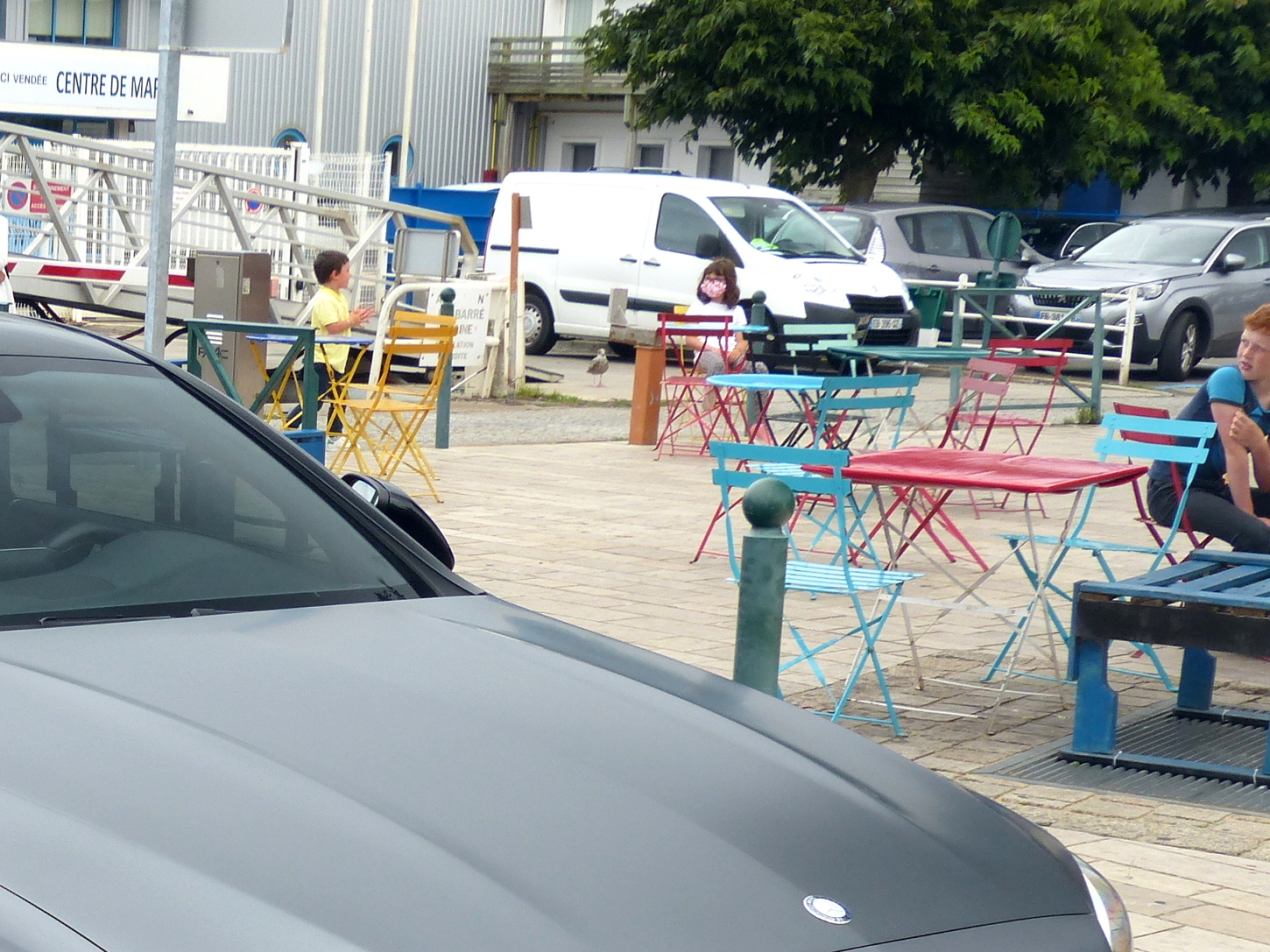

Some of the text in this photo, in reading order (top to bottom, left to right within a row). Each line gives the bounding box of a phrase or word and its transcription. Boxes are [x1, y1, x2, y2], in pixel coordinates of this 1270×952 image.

[13, 73, 48, 87] VENDÉE
[56, 71, 107, 96] CENTRE
[110, 74, 127, 97] DE
